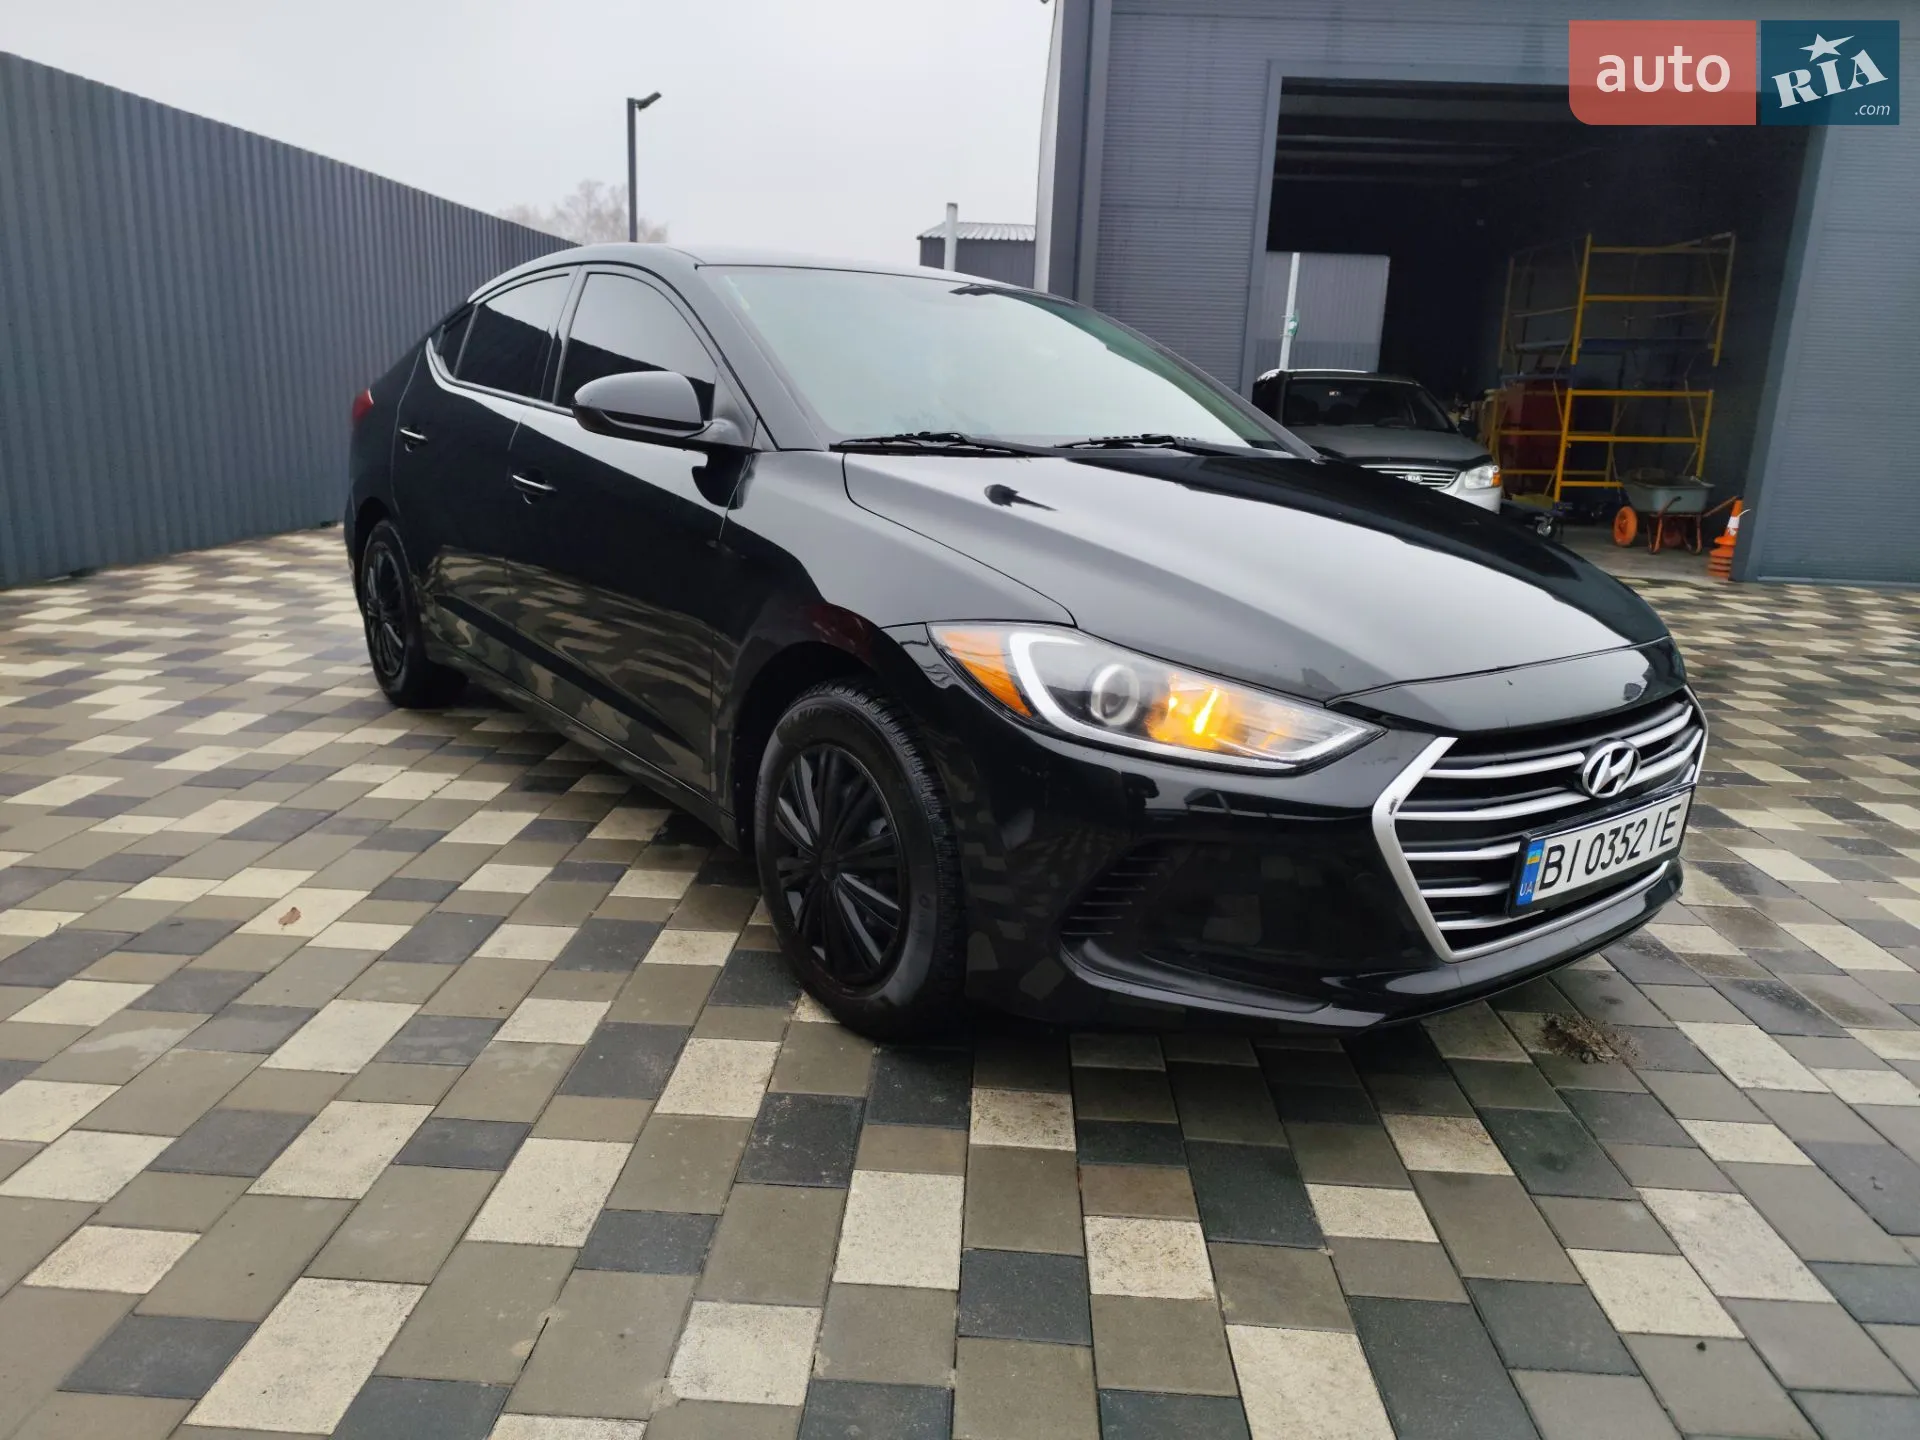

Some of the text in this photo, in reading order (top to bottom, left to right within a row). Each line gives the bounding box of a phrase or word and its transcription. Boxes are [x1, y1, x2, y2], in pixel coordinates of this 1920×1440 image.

[1539, 804, 1681, 890] BI 0352 IE
[1519, 882, 1533, 897] UA
